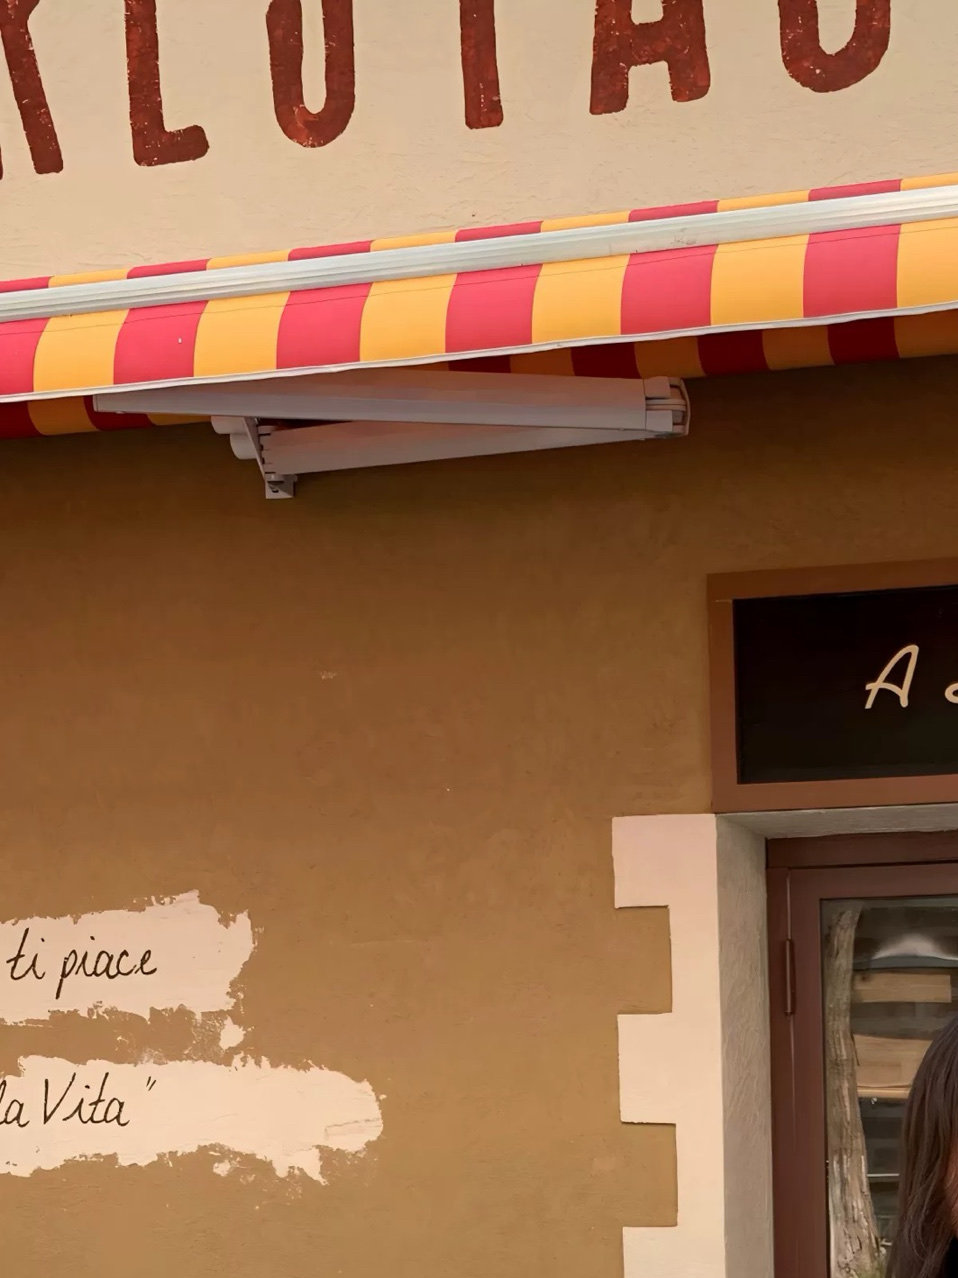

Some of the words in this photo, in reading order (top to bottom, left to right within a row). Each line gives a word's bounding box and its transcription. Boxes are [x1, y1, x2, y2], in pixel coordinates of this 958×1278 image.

[865, 644, 919, 709] A
[6, 927, 46, 980] ti
[56, 935, 157, 1000] piace
